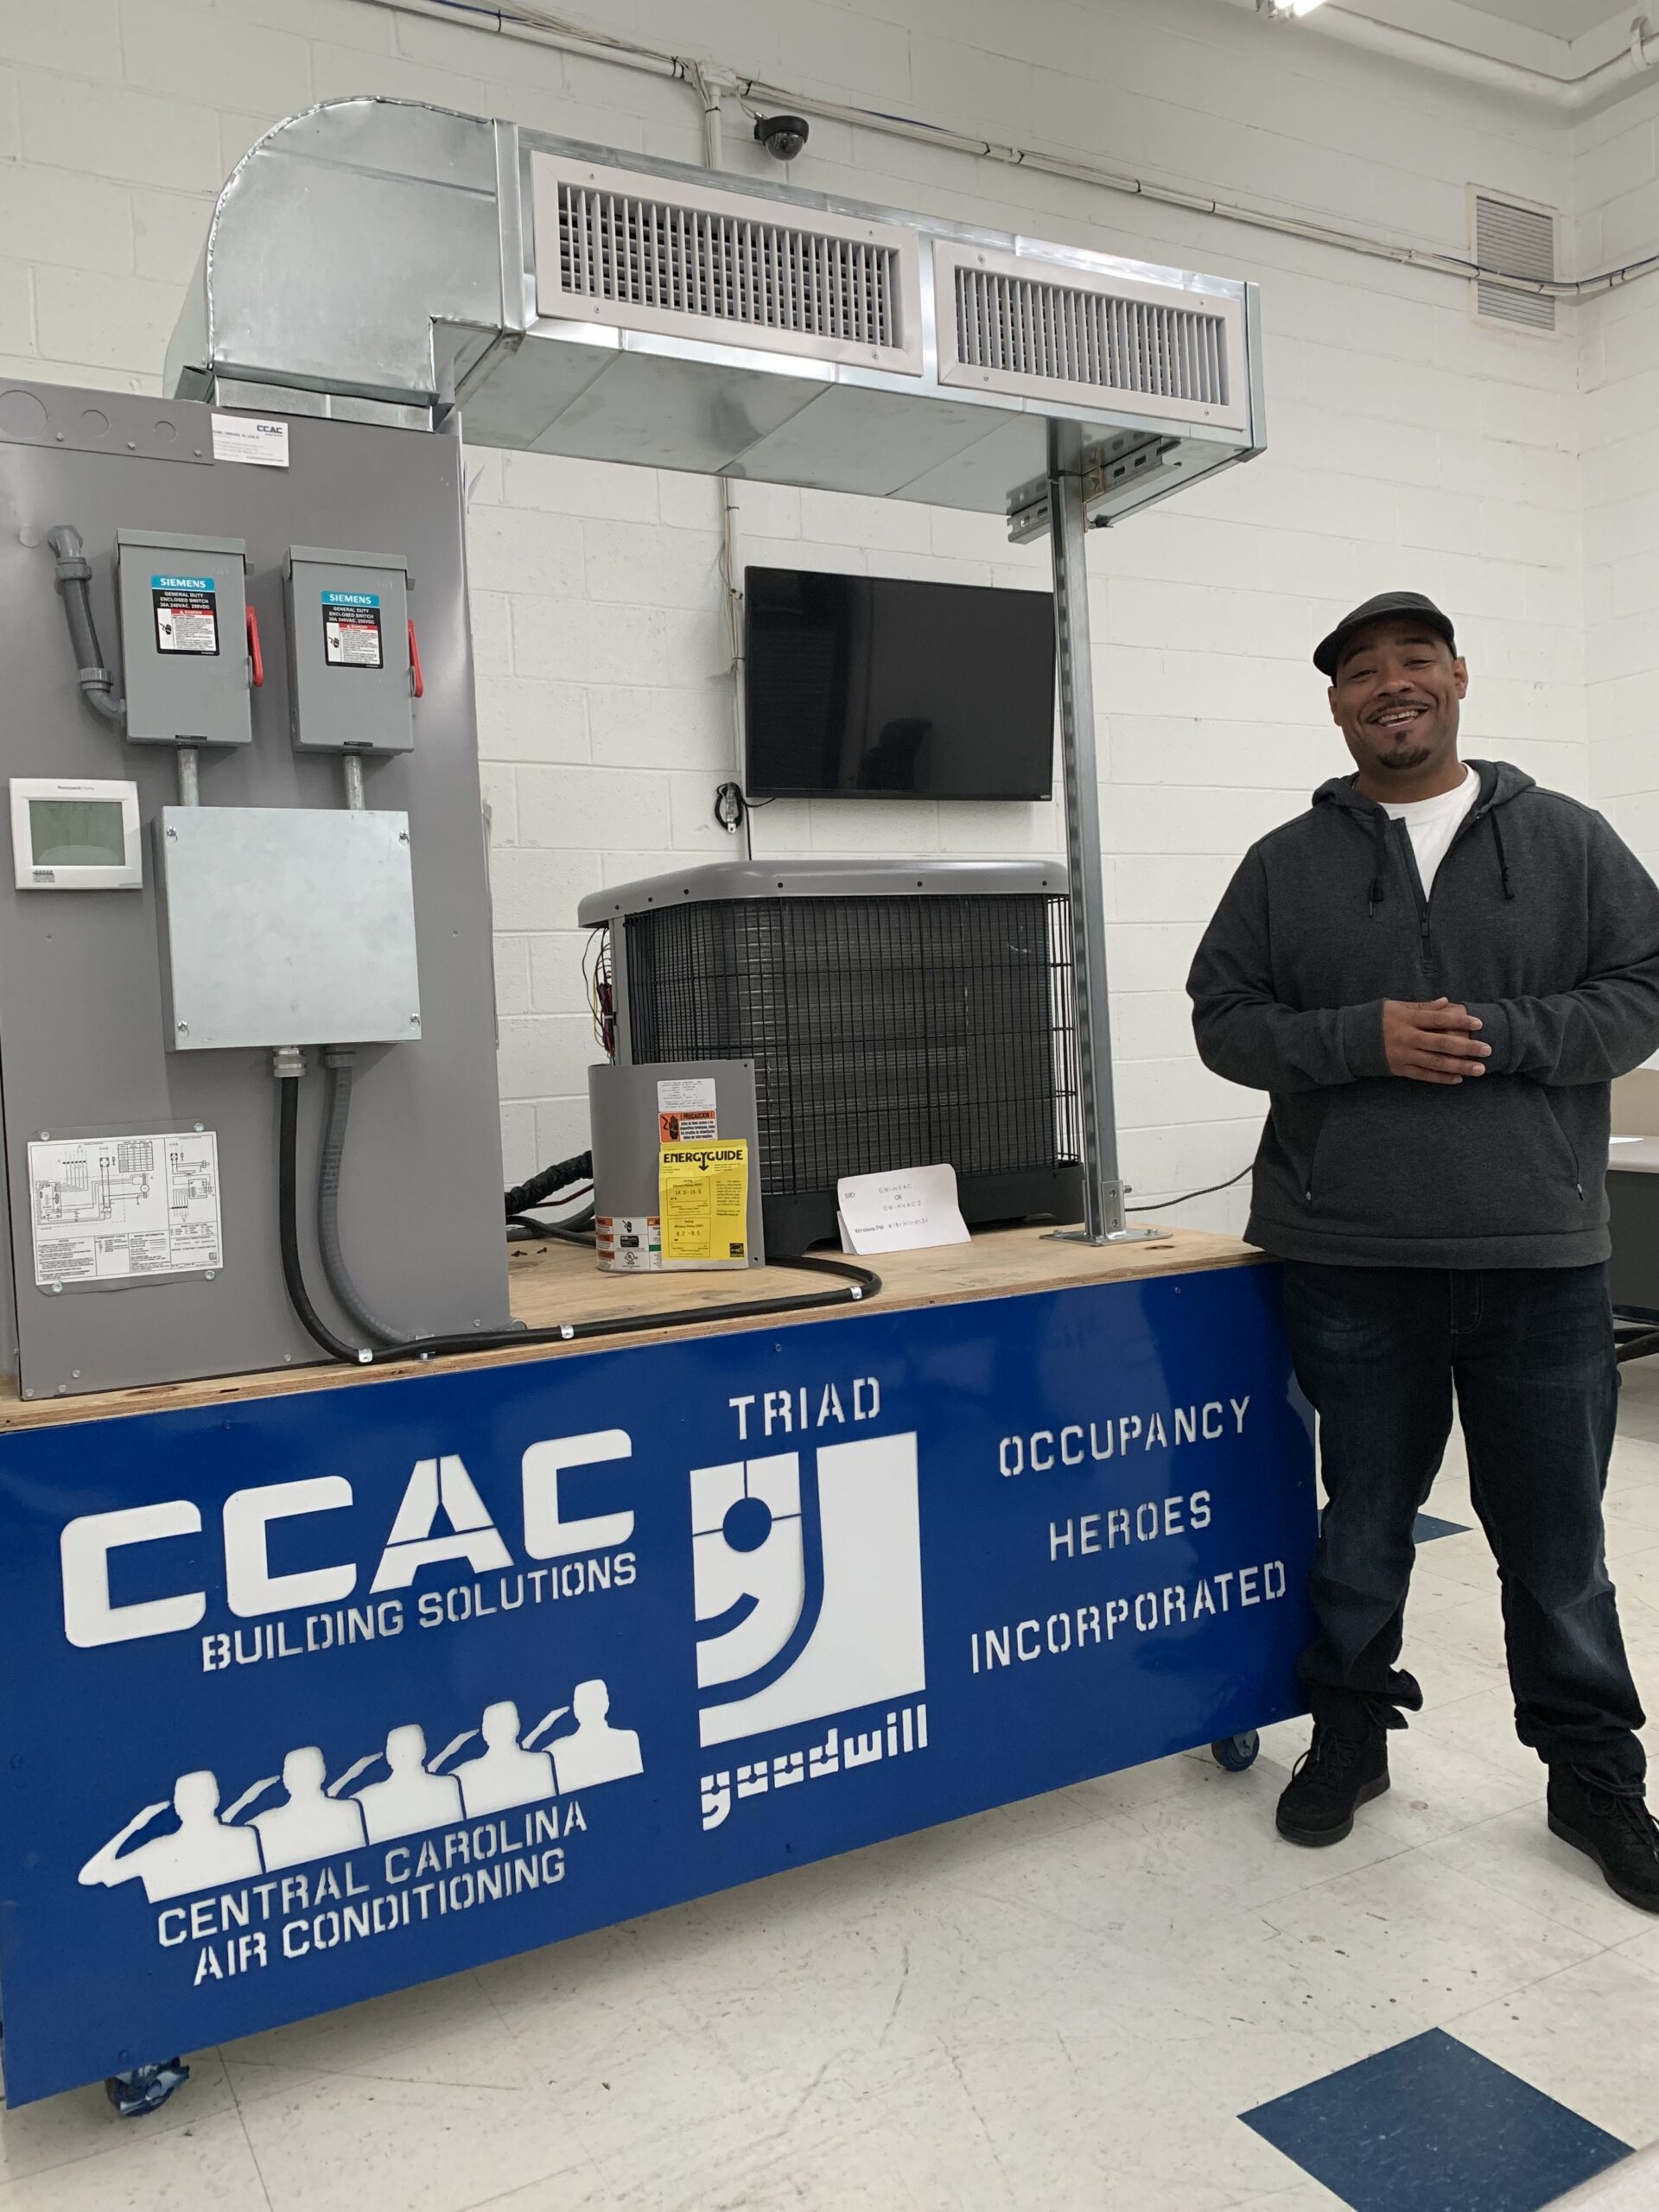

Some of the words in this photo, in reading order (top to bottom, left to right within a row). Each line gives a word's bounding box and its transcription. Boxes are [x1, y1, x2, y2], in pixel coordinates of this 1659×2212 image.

[257, 425, 283, 434] CCAC
[160, 578, 206, 588] SIEMENS
[329, 594, 372, 604] SIEMENS
[729, 1377, 880, 1440] TRIAD
[1000, 1396, 1250, 1477] OCCUPANCY
[60, 1429, 635, 1648] CCAC
[1050, 1491, 1211, 1560] HEROES
[202, 1600, 404, 1672] BUILDING
[419, 1553, 637, 1628] SOLUTIONS
[971, 1560, 1287, 1673] INCORPORATED
[701, 1704, 928, 1831] goodwill
[157, 1860, 369, 1948] CENTRAL
[385, 1801, 588, 1885] CAROLINA
[194, 1932, 267, 1986] AIR
[283, 1849, 566, 1961] CONDITIONING
